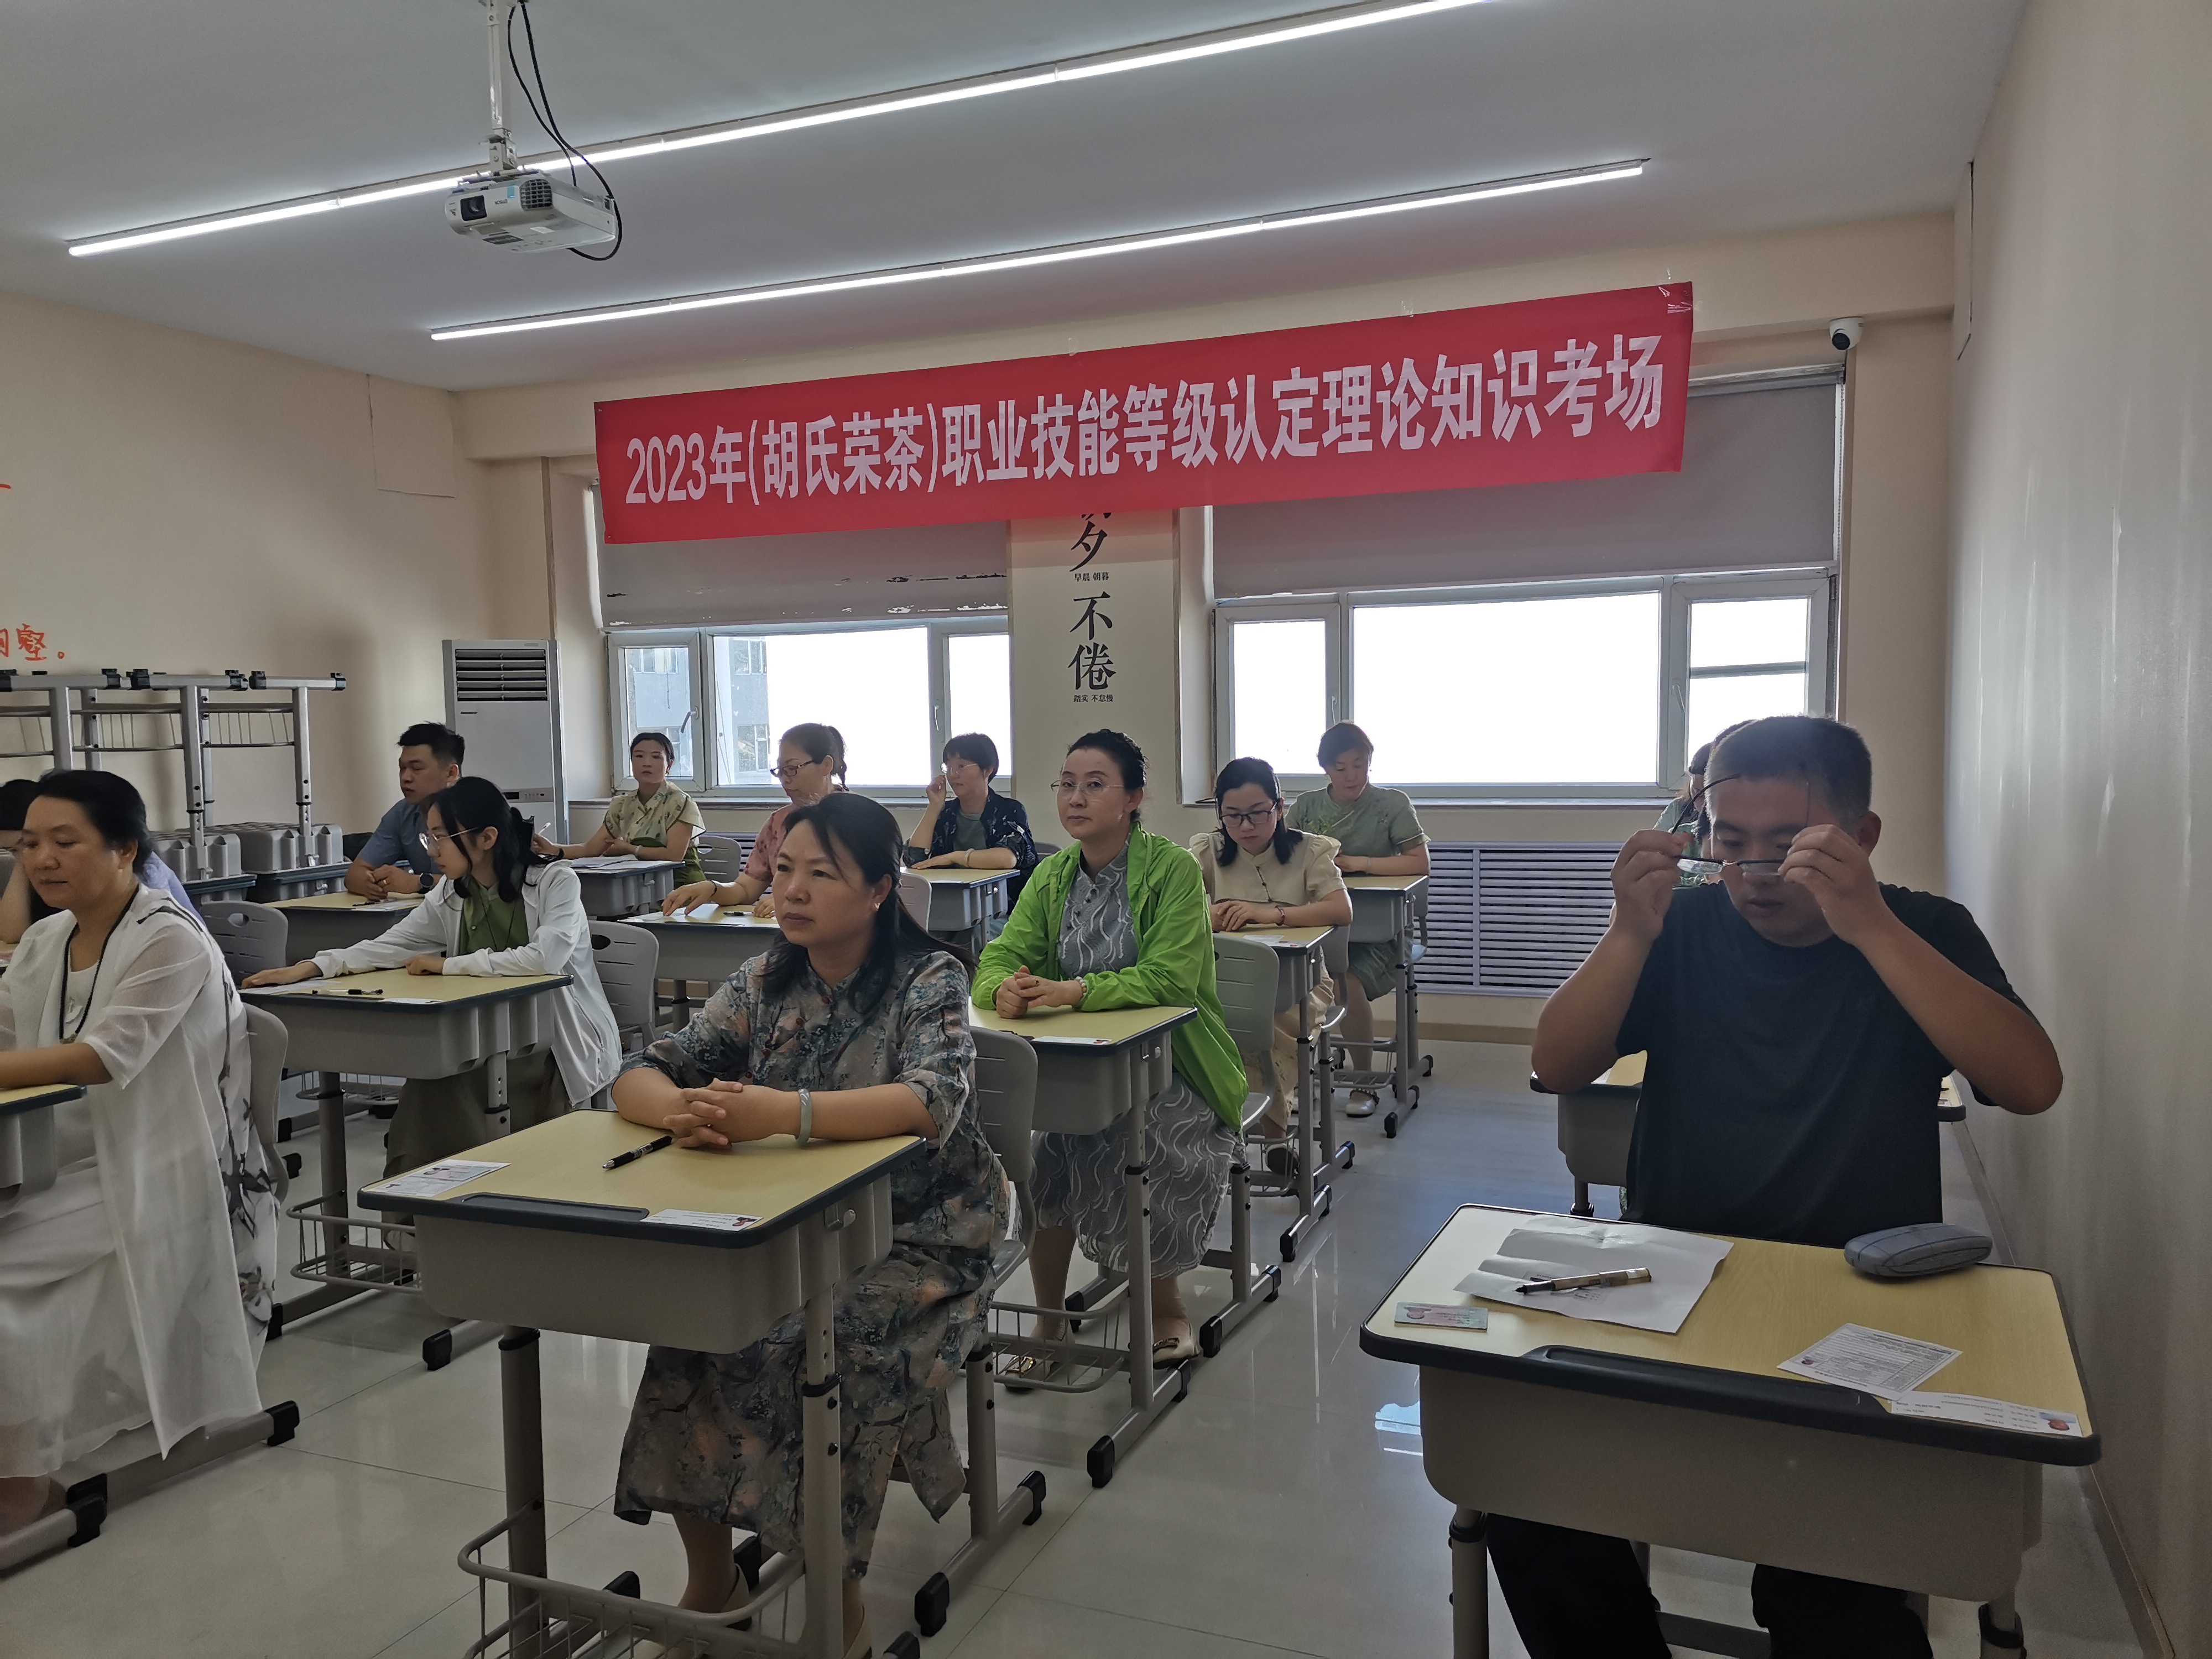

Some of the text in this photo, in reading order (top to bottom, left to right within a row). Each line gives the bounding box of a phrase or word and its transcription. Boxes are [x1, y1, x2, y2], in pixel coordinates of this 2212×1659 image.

[625, 333, 1663, 505] 2023年(胡氏荣茶)职业技能等级认定理论知识考场
